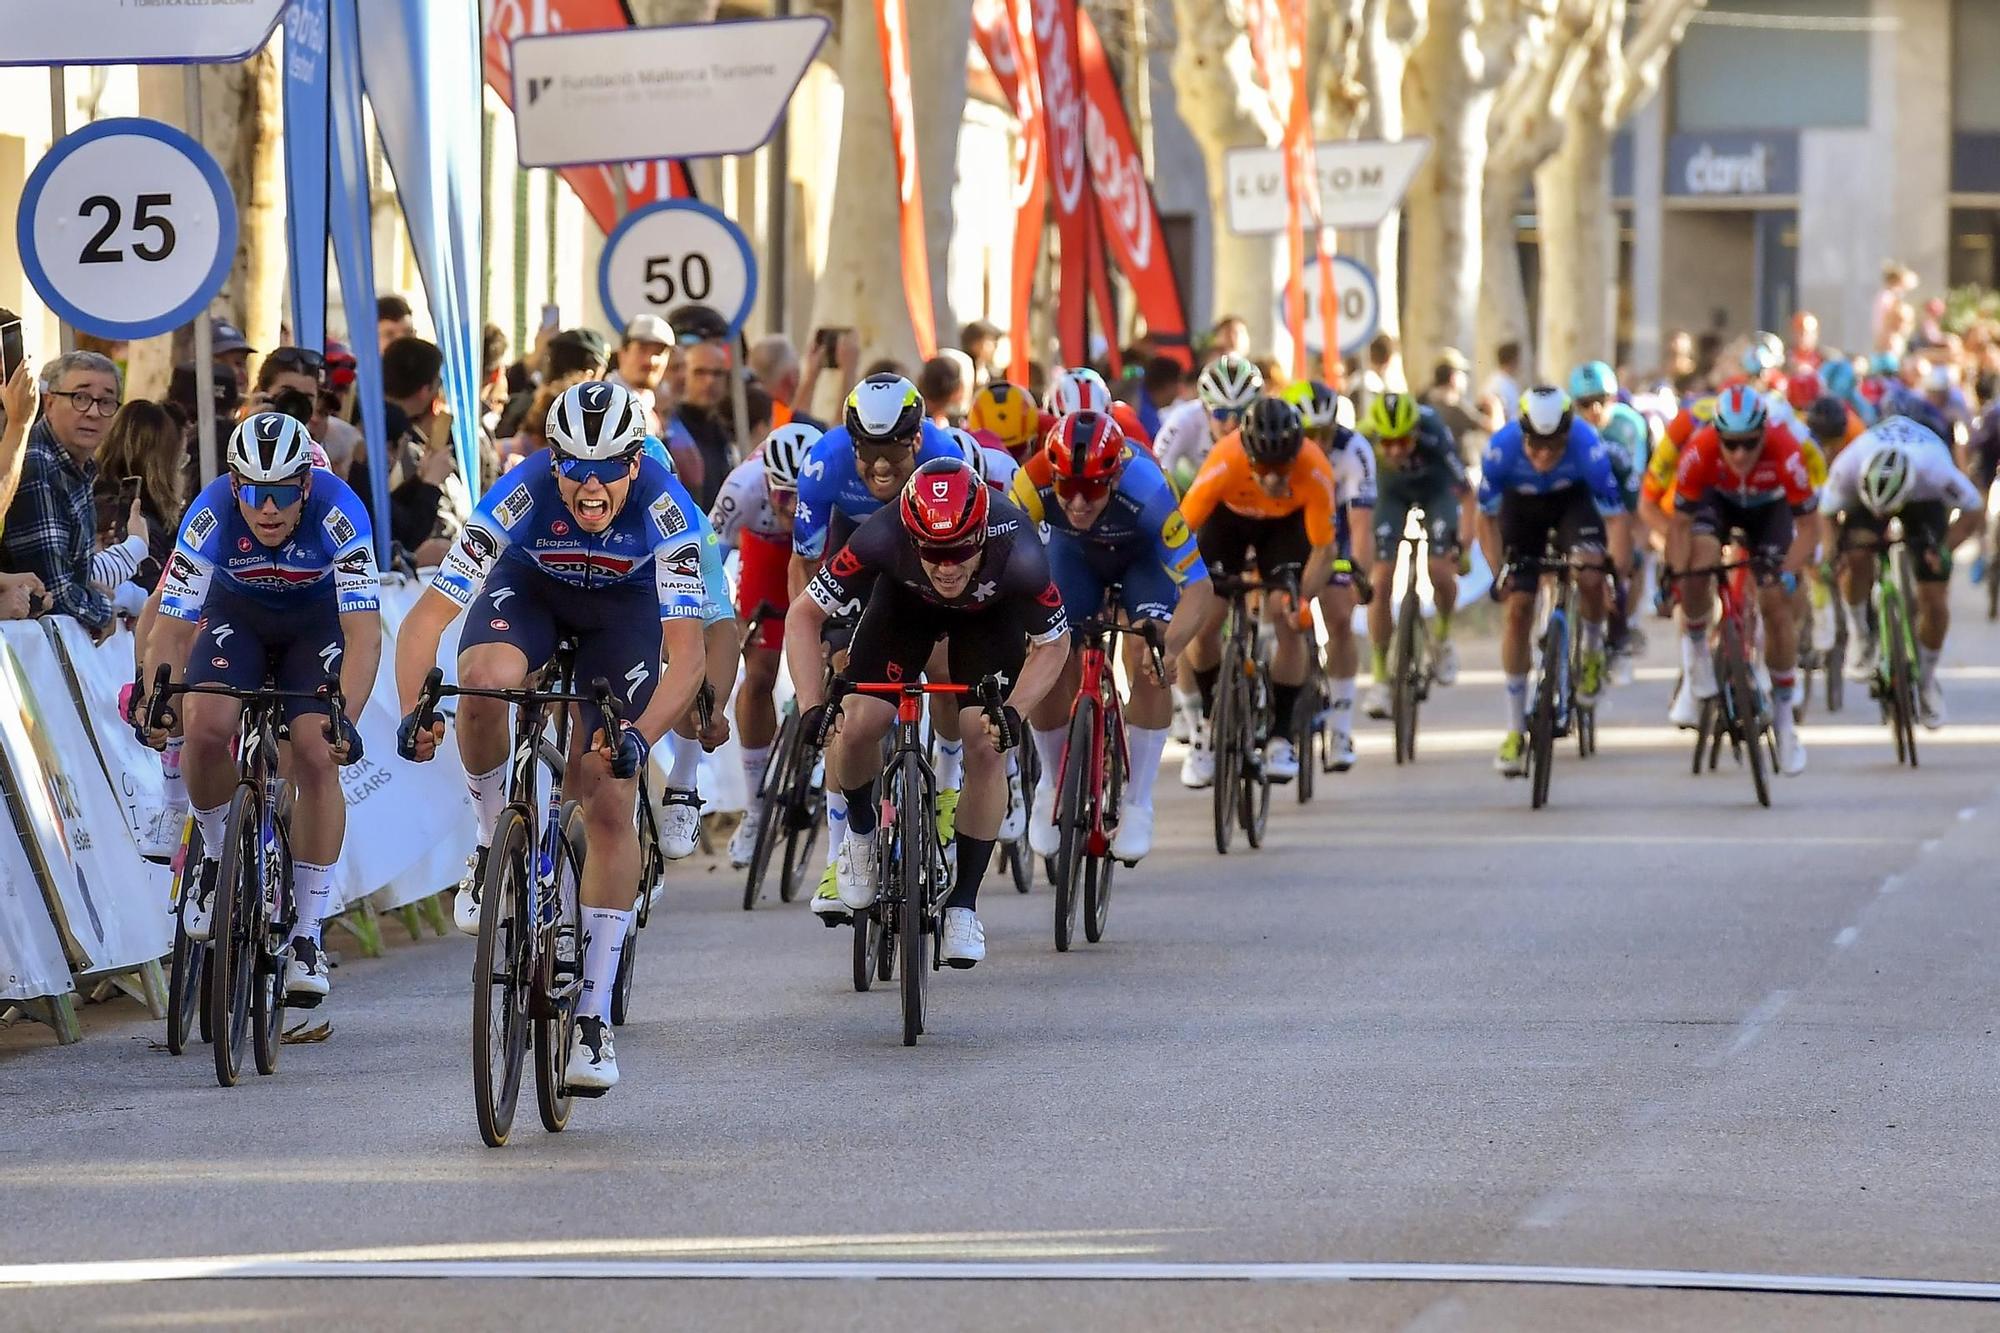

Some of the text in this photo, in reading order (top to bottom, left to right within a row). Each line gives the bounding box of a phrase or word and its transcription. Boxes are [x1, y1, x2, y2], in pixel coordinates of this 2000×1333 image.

[78, 193, 176, 264] 25
[645, 253, 711, 304] 50
[535, 538, 581, 549] Ekopak
[228, 554, 267, 567] Ekopak
